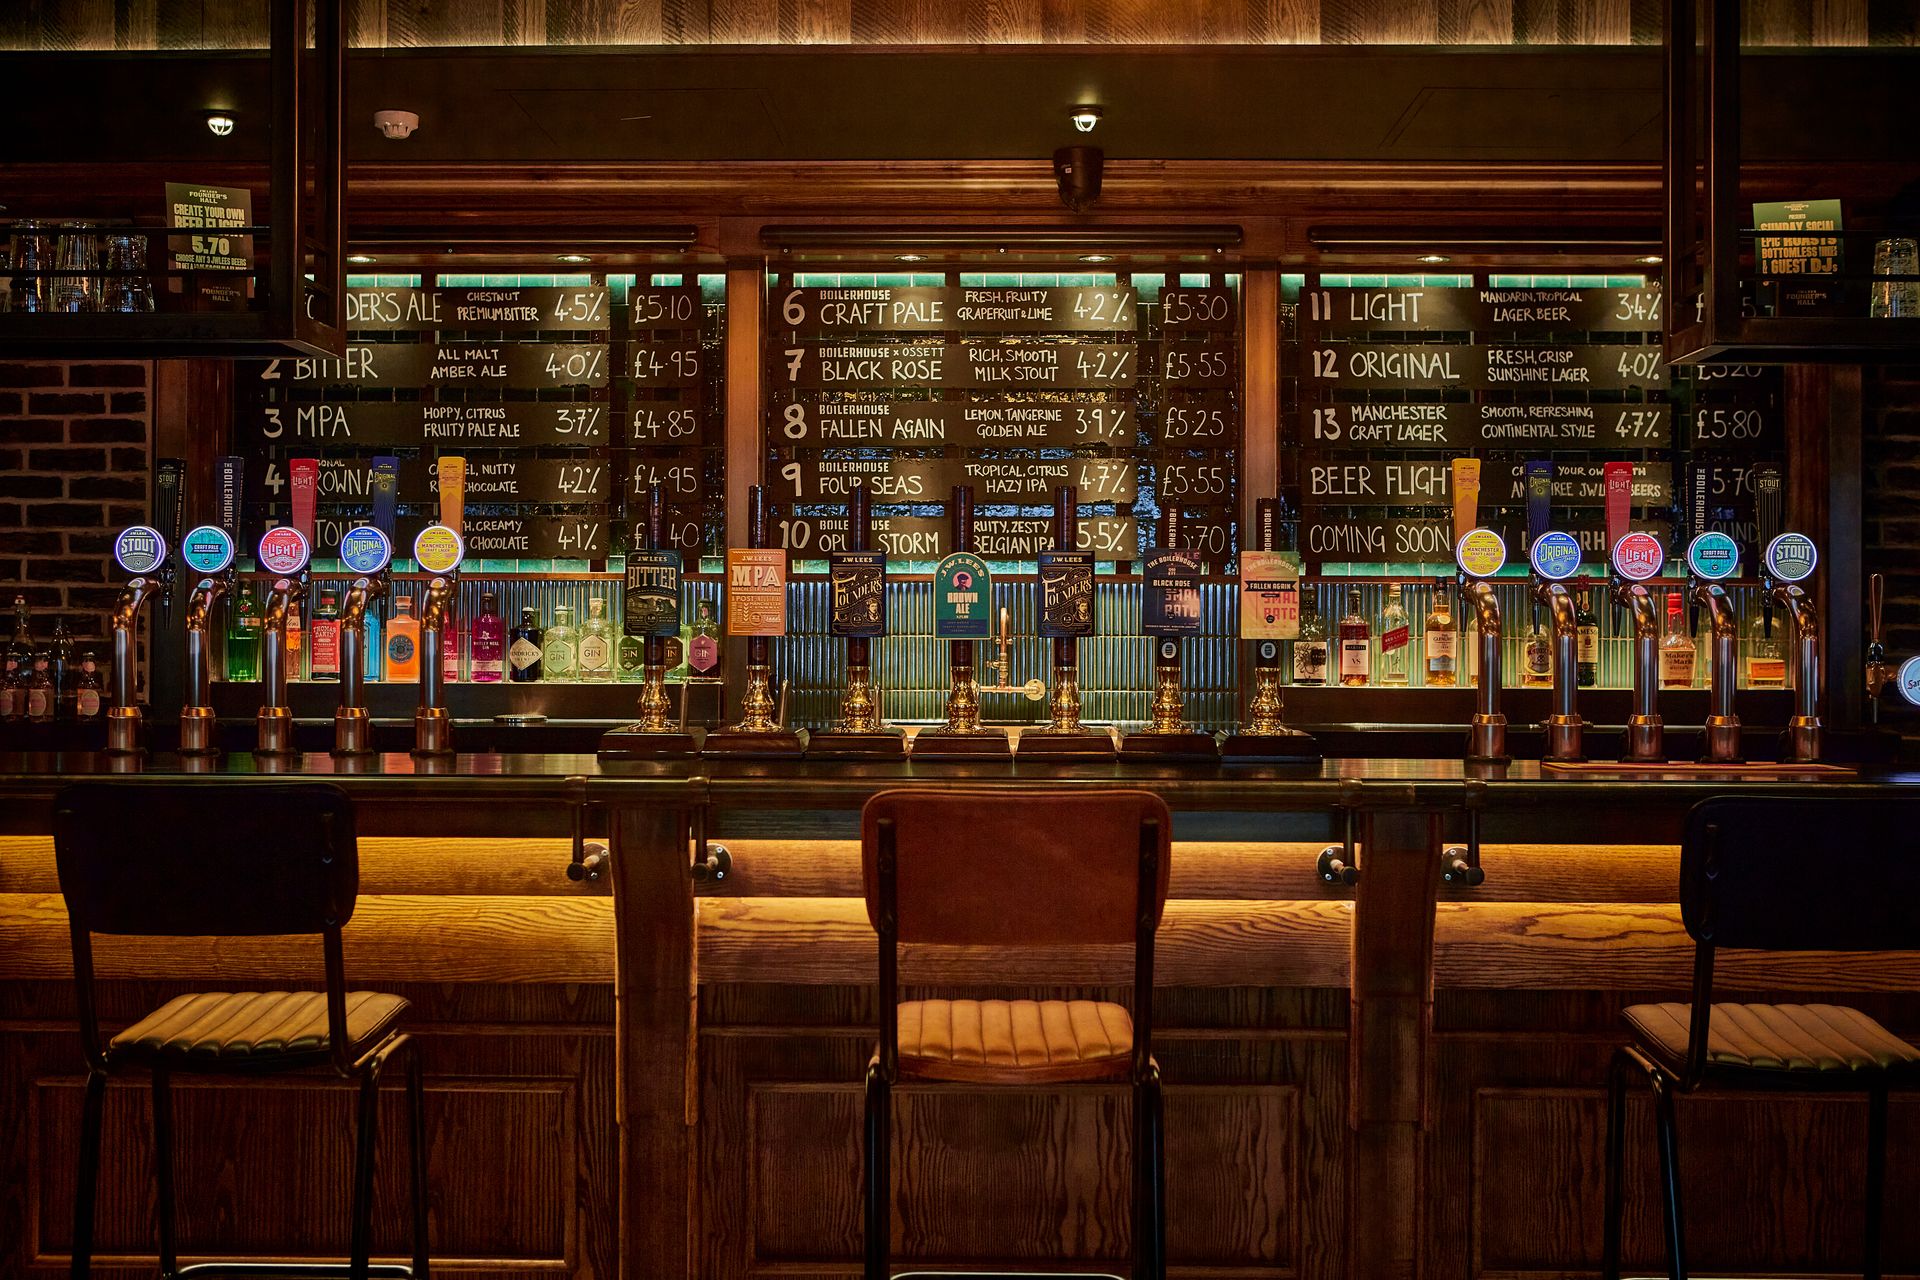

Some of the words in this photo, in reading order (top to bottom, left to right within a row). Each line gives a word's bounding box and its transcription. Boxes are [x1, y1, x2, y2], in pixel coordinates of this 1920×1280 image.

[189, 191, 228, 200] FOUNDER'S
[174, 203, 204, 217] CREATE
[204, 206, 225, 219] YOUR
[226, 208, 245, 220] OWN
[191, 235, 230, 256] 5.70
[1761, 246, 1818, 259] BOTTOMLESS
[1770, 258, 1808, 275] GUEST
[1809, 256, 1838, 273] DJs
[466, 292, 521, 303] CHESTNUT
[819, 289, 891, 301] BOILERHOUSE
[1005, 290, 1048, 304] FRUITY
[1537, 290, 1583, 303] TROPICAL
[407, 292, 443, 322] ALE
[782, 289, 806, 326] 6
[820, 303, 888, 326] CRAFT
[893, 301, 944, 324] PALE
[1309, 290, 1333, 321] 11
[1350, 292, 1425, 323] LIGHT
[1493, 307, 1536, 323] LAGER
[1537, 306, 1572, 322] BEER
[438, 349, 461, 361] ALL
[466, 348, 500, 361] MALT
[819, 347, 890, 358] BOILERHOUSE
[902, 346, 945, 358] OSSETT
[1005, 348, 1057, 364] SMOOTH
[1538, 350, 1574, 364] CRISP
[430, 365, 477, 380] AMBER
[480, 365, 508, 379] ALE
[784, 348, 806, 381] 7
[822, 360, 884, 381] BLACK
[892, 360, 942, 381] ROSE
[1312, 348, 1341, 378] 12
[1349, 350, 1461, 380] ORIGINAL
[975, 366, 1012, 382] MILK
[1014, 365, 1059, 382] STOUT
[1487, 366, 1550, 382] SUNSHINE
[1551, 366, 1591, 382] LAGER
[465, 407, 507, 420] CITRUS
[819, 404, 890, 416] BOILERHOUSE
[1004, 407, 1062, 422] TANGERINE
[1350, 405, 1449, 422] MANCHESTER
[1529, 406, 1594, 420] REFRESHING
[263, 407, 285, 439] 3
[297, 405, 353, 438] MPA
[783, 403, 808, 439] 8
[820, 418, 883, 439] FALLEN
[891, 418, 945, 439] AGAIN
[1311, 408, 1342, 440] 13
[424, 422, 465, 438] FRUITY
[467, 423, 498, 438] PALE
[498, 424, 521, 438] ALE
[976, 423, 1023, 439] GOLDEN
[1026, 423, 1048, 438] ALE
[1349, 424, 1393, 441] CRAFT
[1397, 424, 1449, 442] LAGER
[1481, 423, 1560, 439] CONTINENTAL
[1561, 423, 1597, 439] STYLE
[481, 463, 517, 477] NUTTY
[819, 462, 889, 474] BOILERHOUSE
[1026, 464, 1069, 478] CITRUS
[1557, 465, 1588, 478] YOUR
[264, 462, 286, 496] 4
[781, 462, 802, 497] 9
[872, 474, 923, 496] SEAS
[986, 478, 1022, 494] HAZY
[1026, 478, 1048, 493] IPA
[1311, 465, 1377, 497] BEER
[223, 467, 233, 529] BOILERHOUSE
[1694, 474, 1706, 535] BOILERHOUSE
[779, 519, 811, 550] 10
[1011, 520, 1050, 535] ZESTY
[121, 537, 156, 555] STOUT
[469, 536, 529, 551] CHOCOLATE
[877, 531, 940, 555] STORM
[1309, 522, 1387, 555] COMING
[1395, 522, 1454, 555] SOON
[268, 542, 298, 560] LIGHT
[346, 538, 384, 560] ORIGINAL
[1540, 544, 1578, 564] ORIGINAL
[1624, 547, 1655, 565] LIGHT
[1775, 543, 1812, 562] STOUT
[627, 566, 679, 592] BITTER
[732, 566, 782, 587] MPA
[1153, 579, 1174, 587] BLACK
[1174, 579, 1191, 588] ROSE
[955, 603, 971, 614] ALE
[550, 653, 565, 661] GIN
[584, 649, 602, 658] GIN
[622, 650, 639, 658] GIN
[695, 650, 711, 658] GIN
